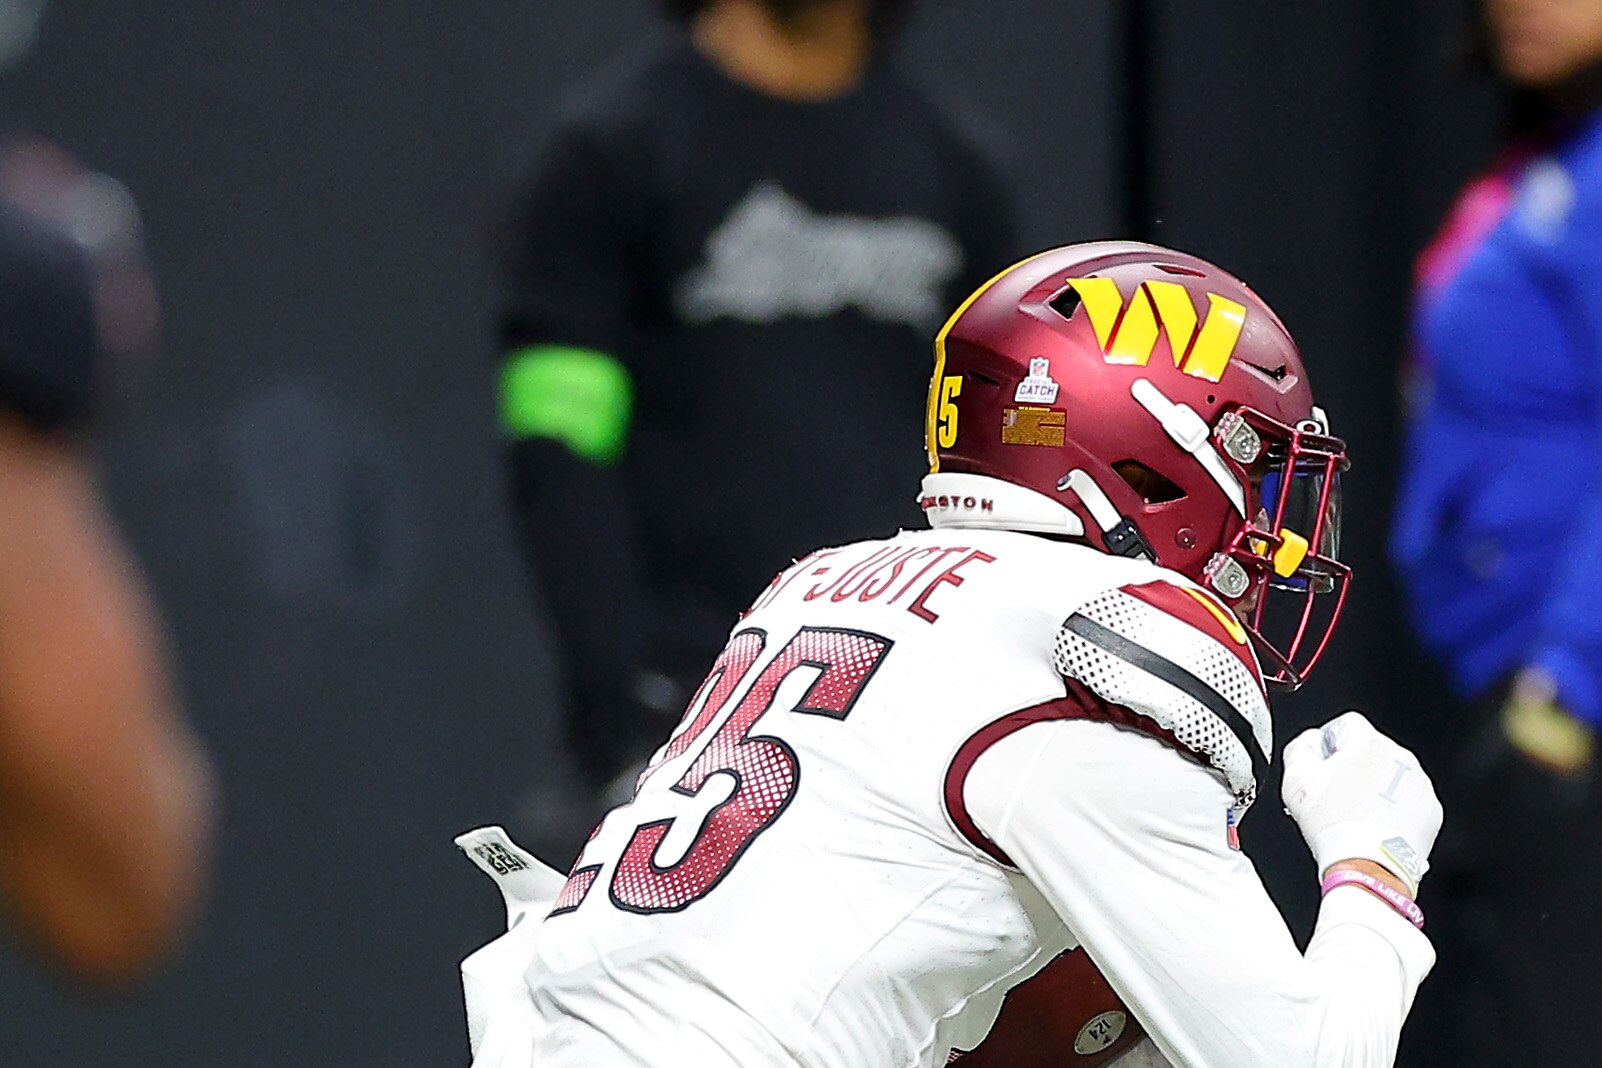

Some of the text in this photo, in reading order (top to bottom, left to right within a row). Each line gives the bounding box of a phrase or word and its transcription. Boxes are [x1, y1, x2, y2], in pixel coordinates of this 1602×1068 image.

[1019, 384, 1056, 397] CATCH
[938, 375, 963, 449] 5
[1377, 883, 1406, 907] LIKE
